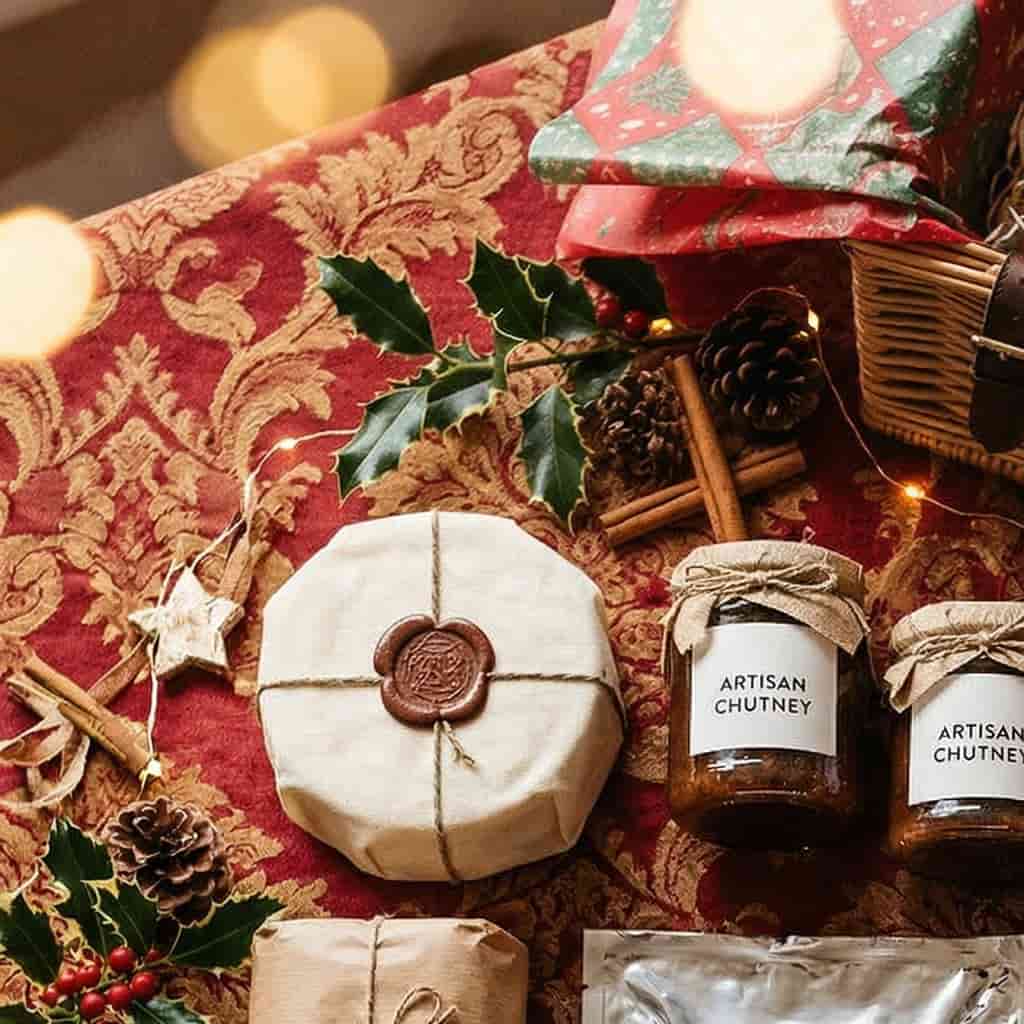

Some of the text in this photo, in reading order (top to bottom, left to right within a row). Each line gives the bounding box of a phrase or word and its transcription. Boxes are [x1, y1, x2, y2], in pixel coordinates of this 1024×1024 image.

[719, 673, 806, 693] ARTISAN
[714, 696, 812, 716] CHUTNEY
[938, 723, 1024, 743] ARTISAN
